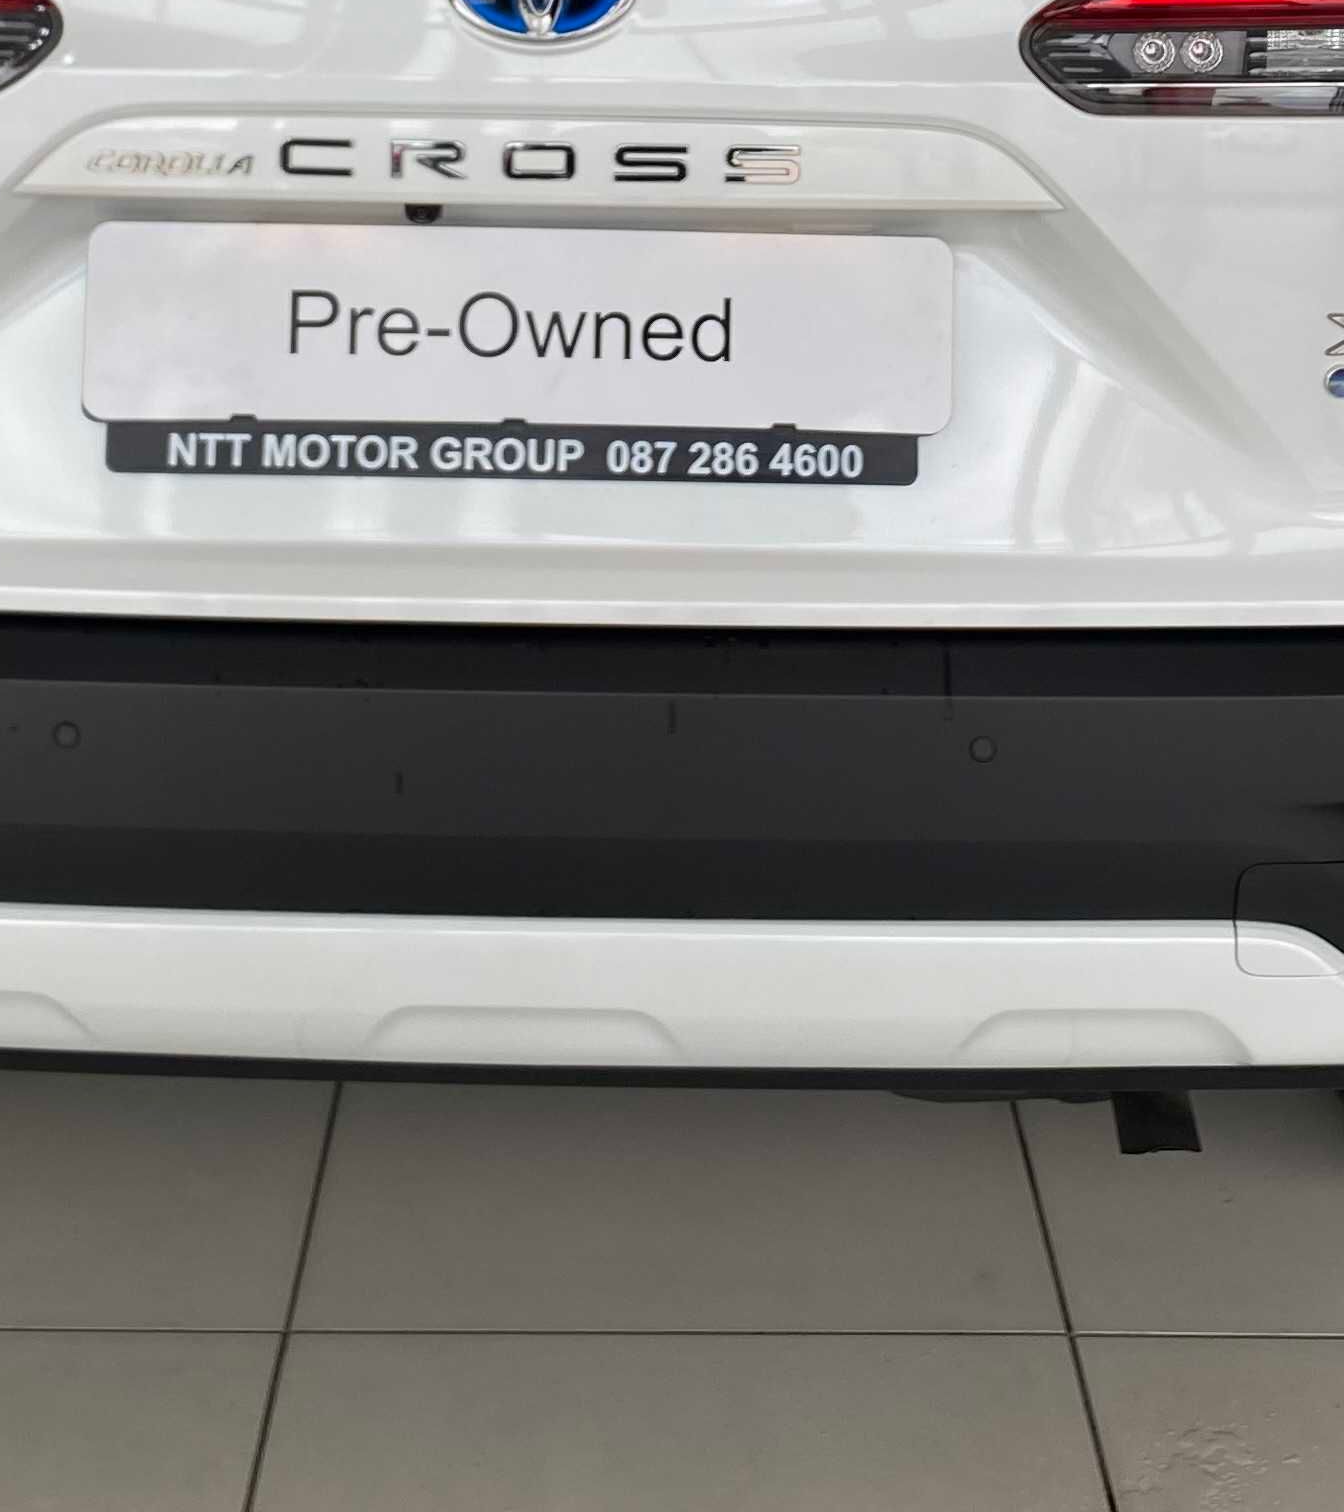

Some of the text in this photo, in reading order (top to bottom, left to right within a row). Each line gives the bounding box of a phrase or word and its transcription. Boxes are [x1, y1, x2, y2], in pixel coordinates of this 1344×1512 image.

[85, 137, 802, 185] COROLLA CROSS
[288, 289, 733, 363] Pre-Owned
[166, 432, 865, 478] NTT MOTOR GROUP 087 286 4600
